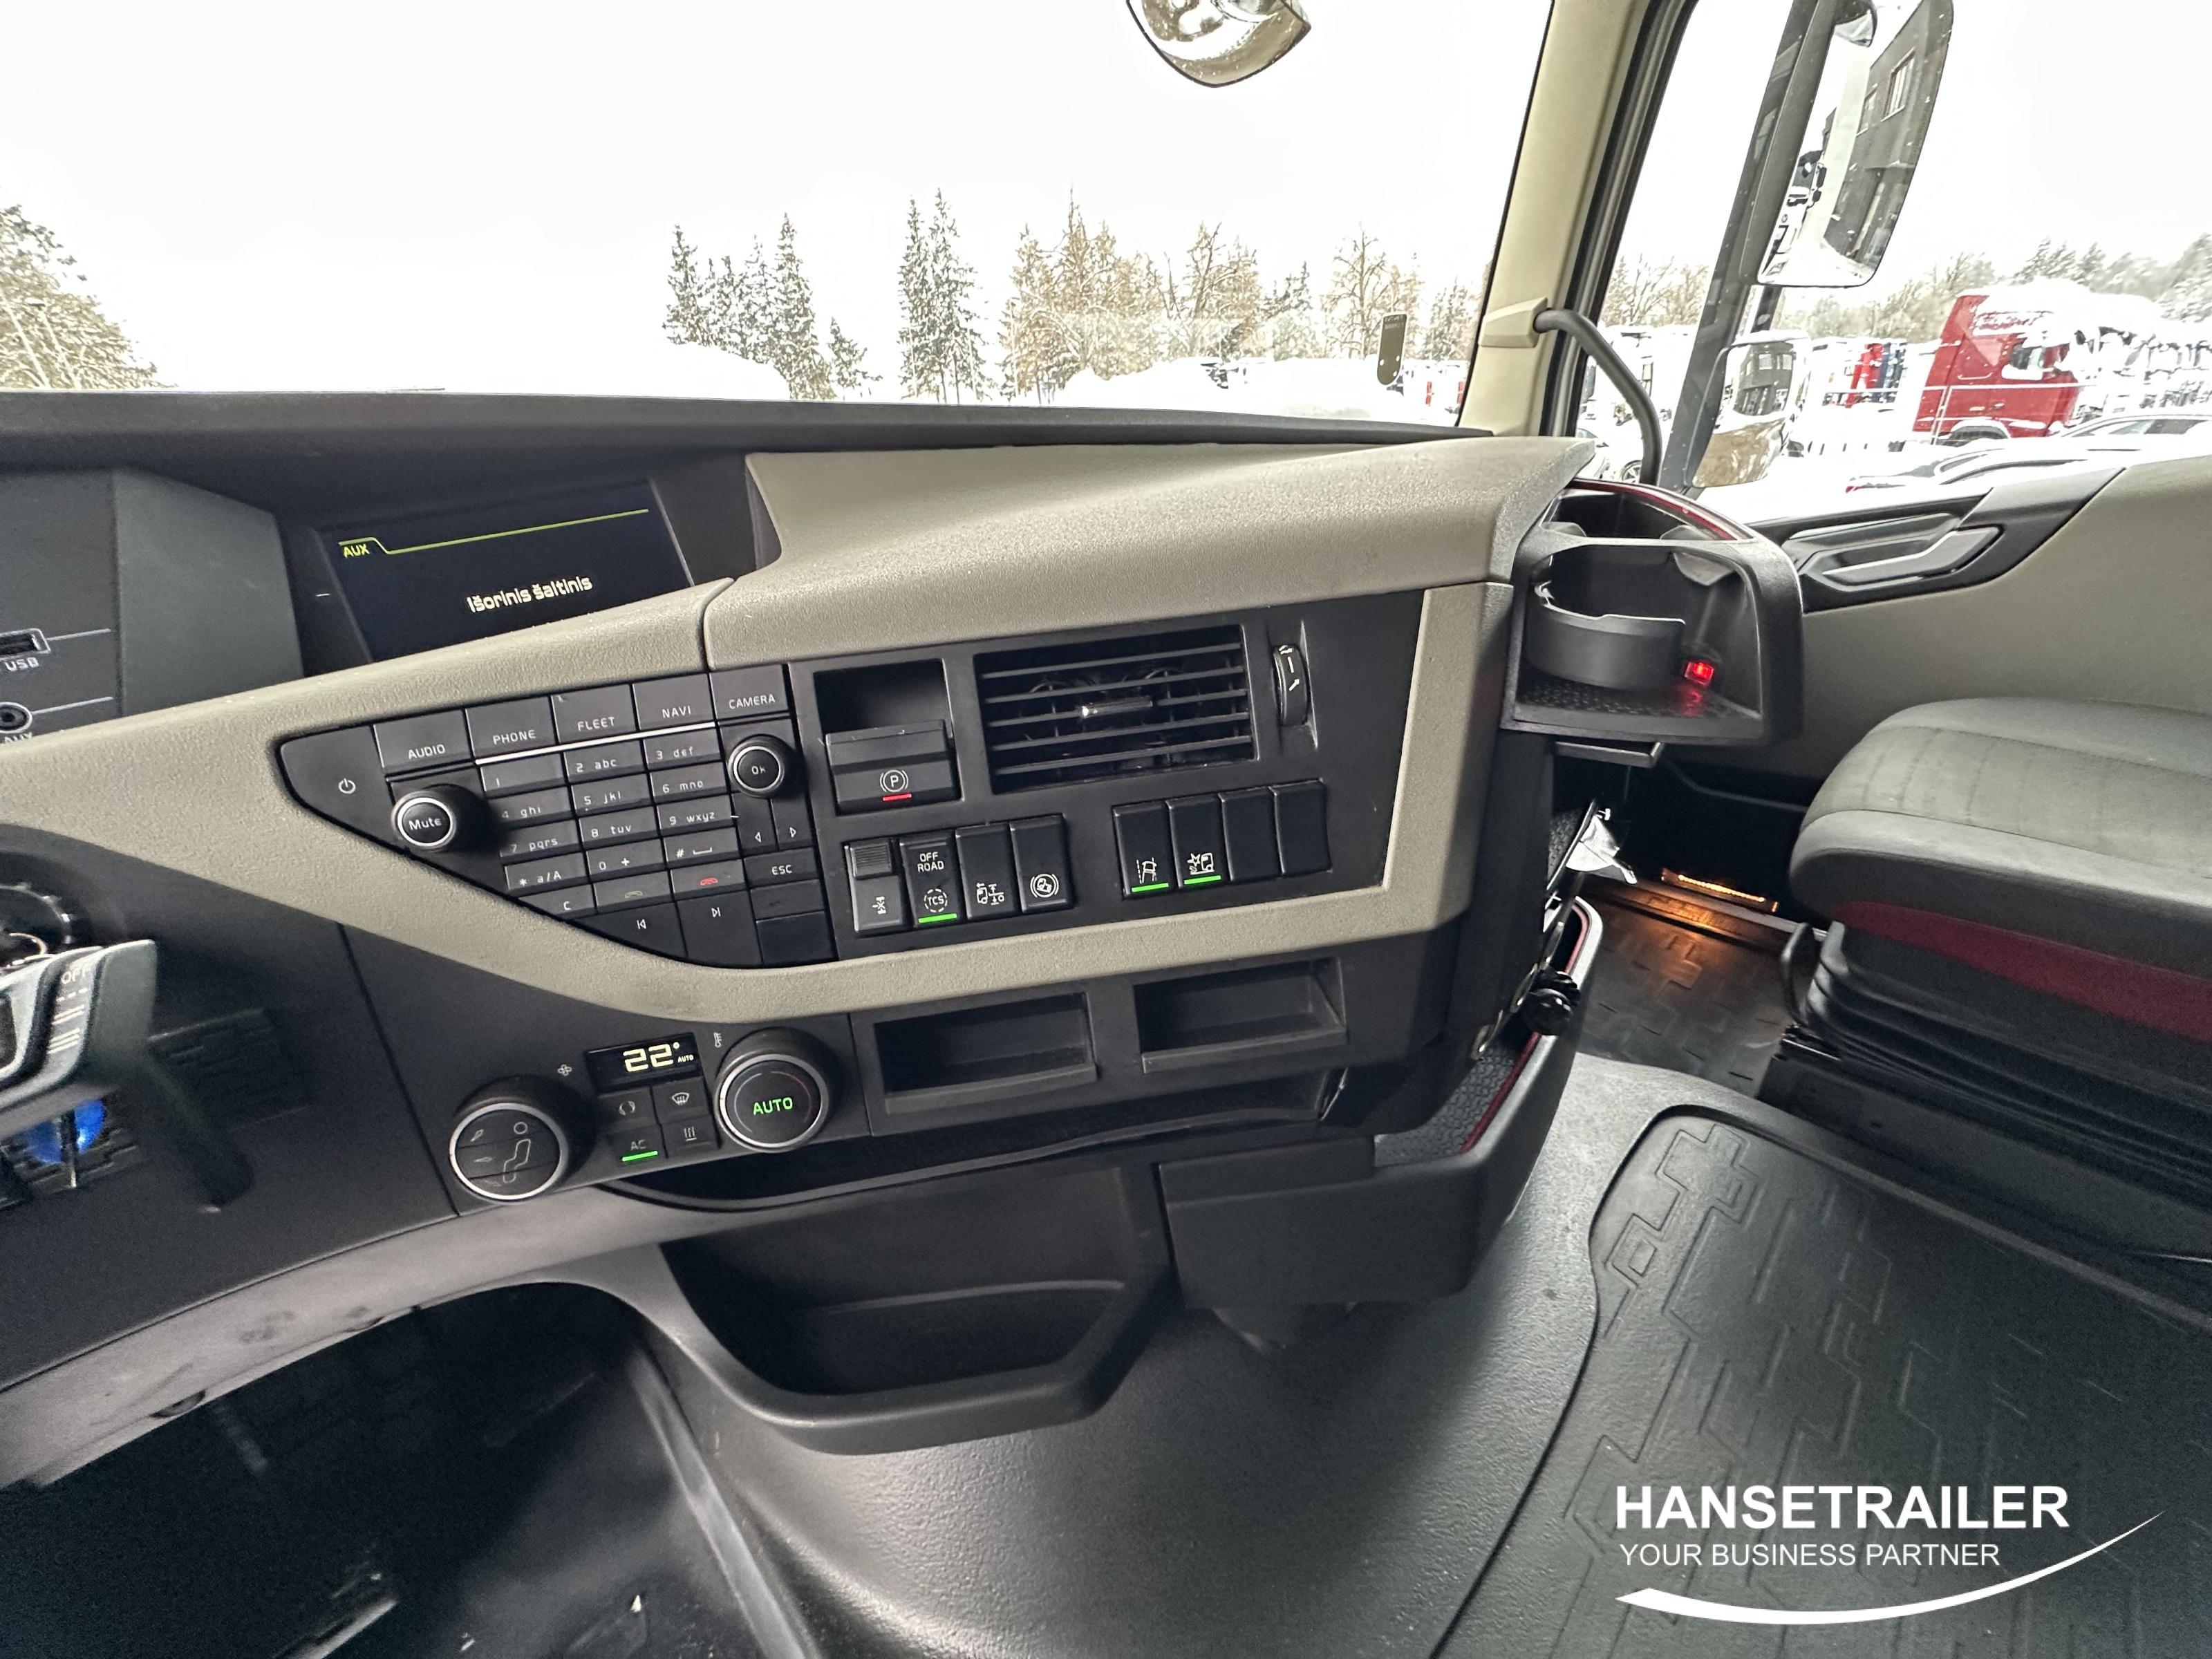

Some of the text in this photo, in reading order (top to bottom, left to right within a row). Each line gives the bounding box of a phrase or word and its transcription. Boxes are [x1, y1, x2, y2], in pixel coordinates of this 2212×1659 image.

[344, 544, 370, 558] AUX
[467, 576, 593, 613] Išorinis šaltinis
[5, 657, 39, 671] USB
[729, 693, 776, 709] CAMERA
[662, 705, 692, 718] NAVI
[577, 716, 615, 732] FLEET
[493, 729, 536, 745] PHONE
[408, 744, 446, 760] AUDIO
[656, 747, 693, 760] 3 def
[576, 758, 617, 773] 2 abc
[662, 780, 704, 794] 6 mno
[584, 791, 621, 805] 5 jkl
[521, 806, 541, 818] ghi
[669, 812, 715, 825] 9 wxyz
[408, 817, 442, 830] Mute
[591, 825, 632, 838] 8 tuv
[511, 838, 559, 853] 7 pqrs
[919, 852, 938, 862] OFF
[771, 865, 792, 875] ESC
[917, 861, 944, 873] ROAD
[537, 870, 562, 884] a/A
[563, 901, 571, 911] C
[927, 895, 945, 906] TCS
[677, 1054, 694, 1063] AUTO
[753, 1097, 793, 1115] AUTO
[630, 1139, 647, 1151] AC
